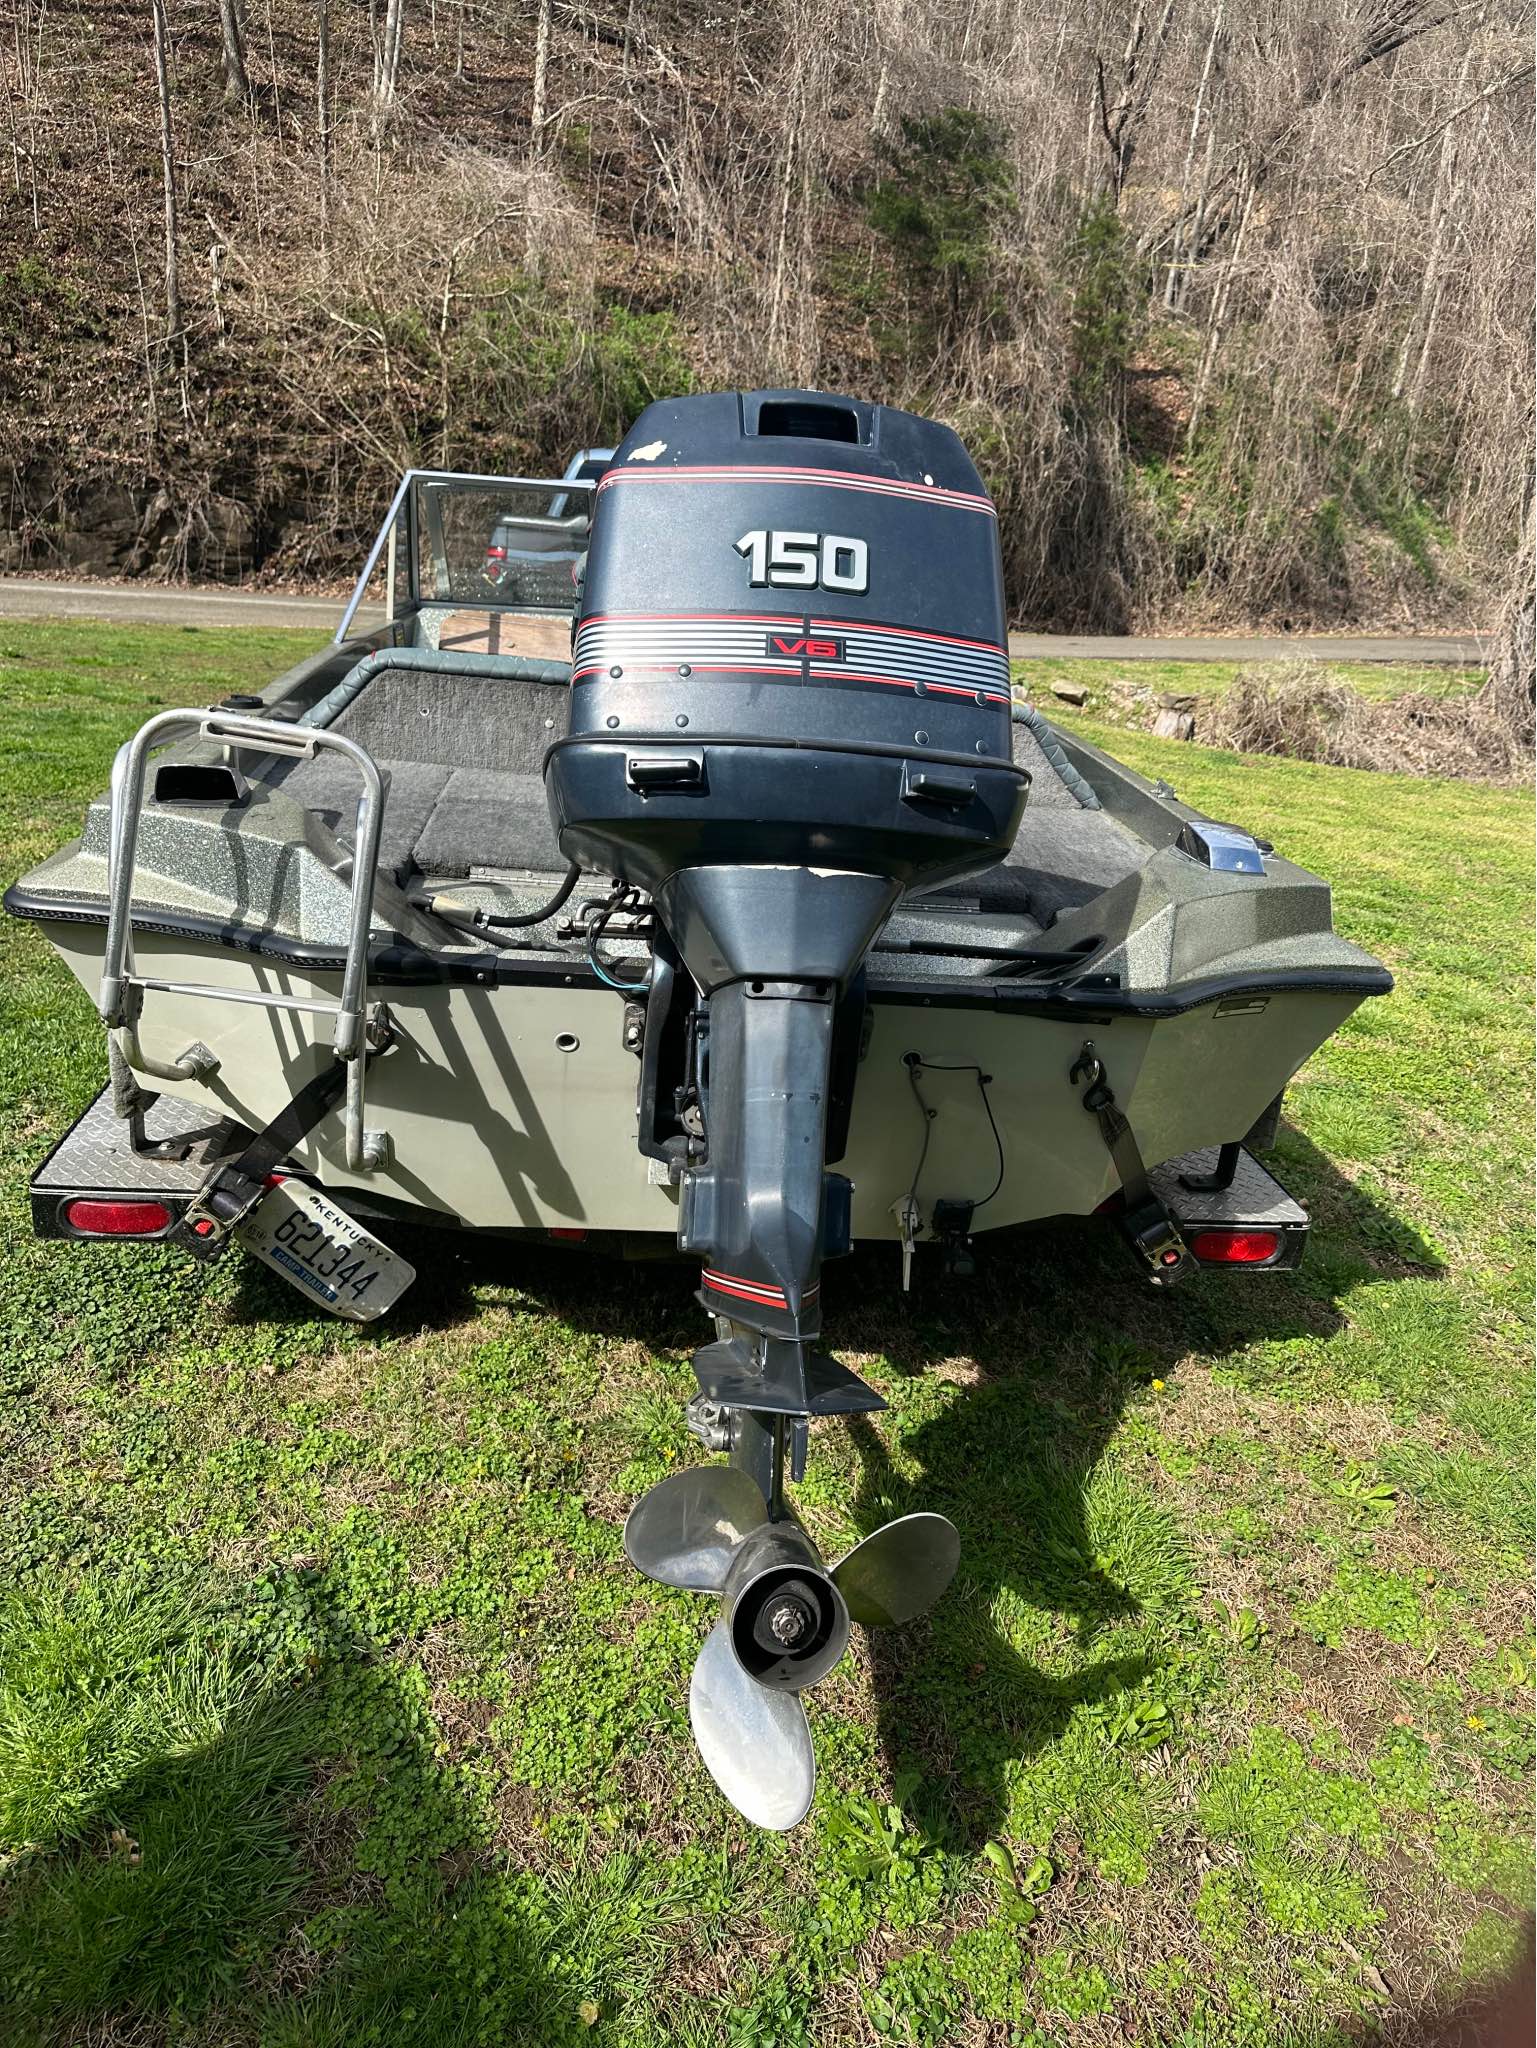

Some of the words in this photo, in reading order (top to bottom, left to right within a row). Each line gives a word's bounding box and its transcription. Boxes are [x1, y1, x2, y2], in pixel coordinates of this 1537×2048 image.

[733, 530, 869, 596] 150
[772, 636, 837, 657] V6
[274, 1210, 380, 1300] 621344
[317, 1203, 383, 1258] KENTUCKY
[275, 1250, 301, 1273] CAMP
